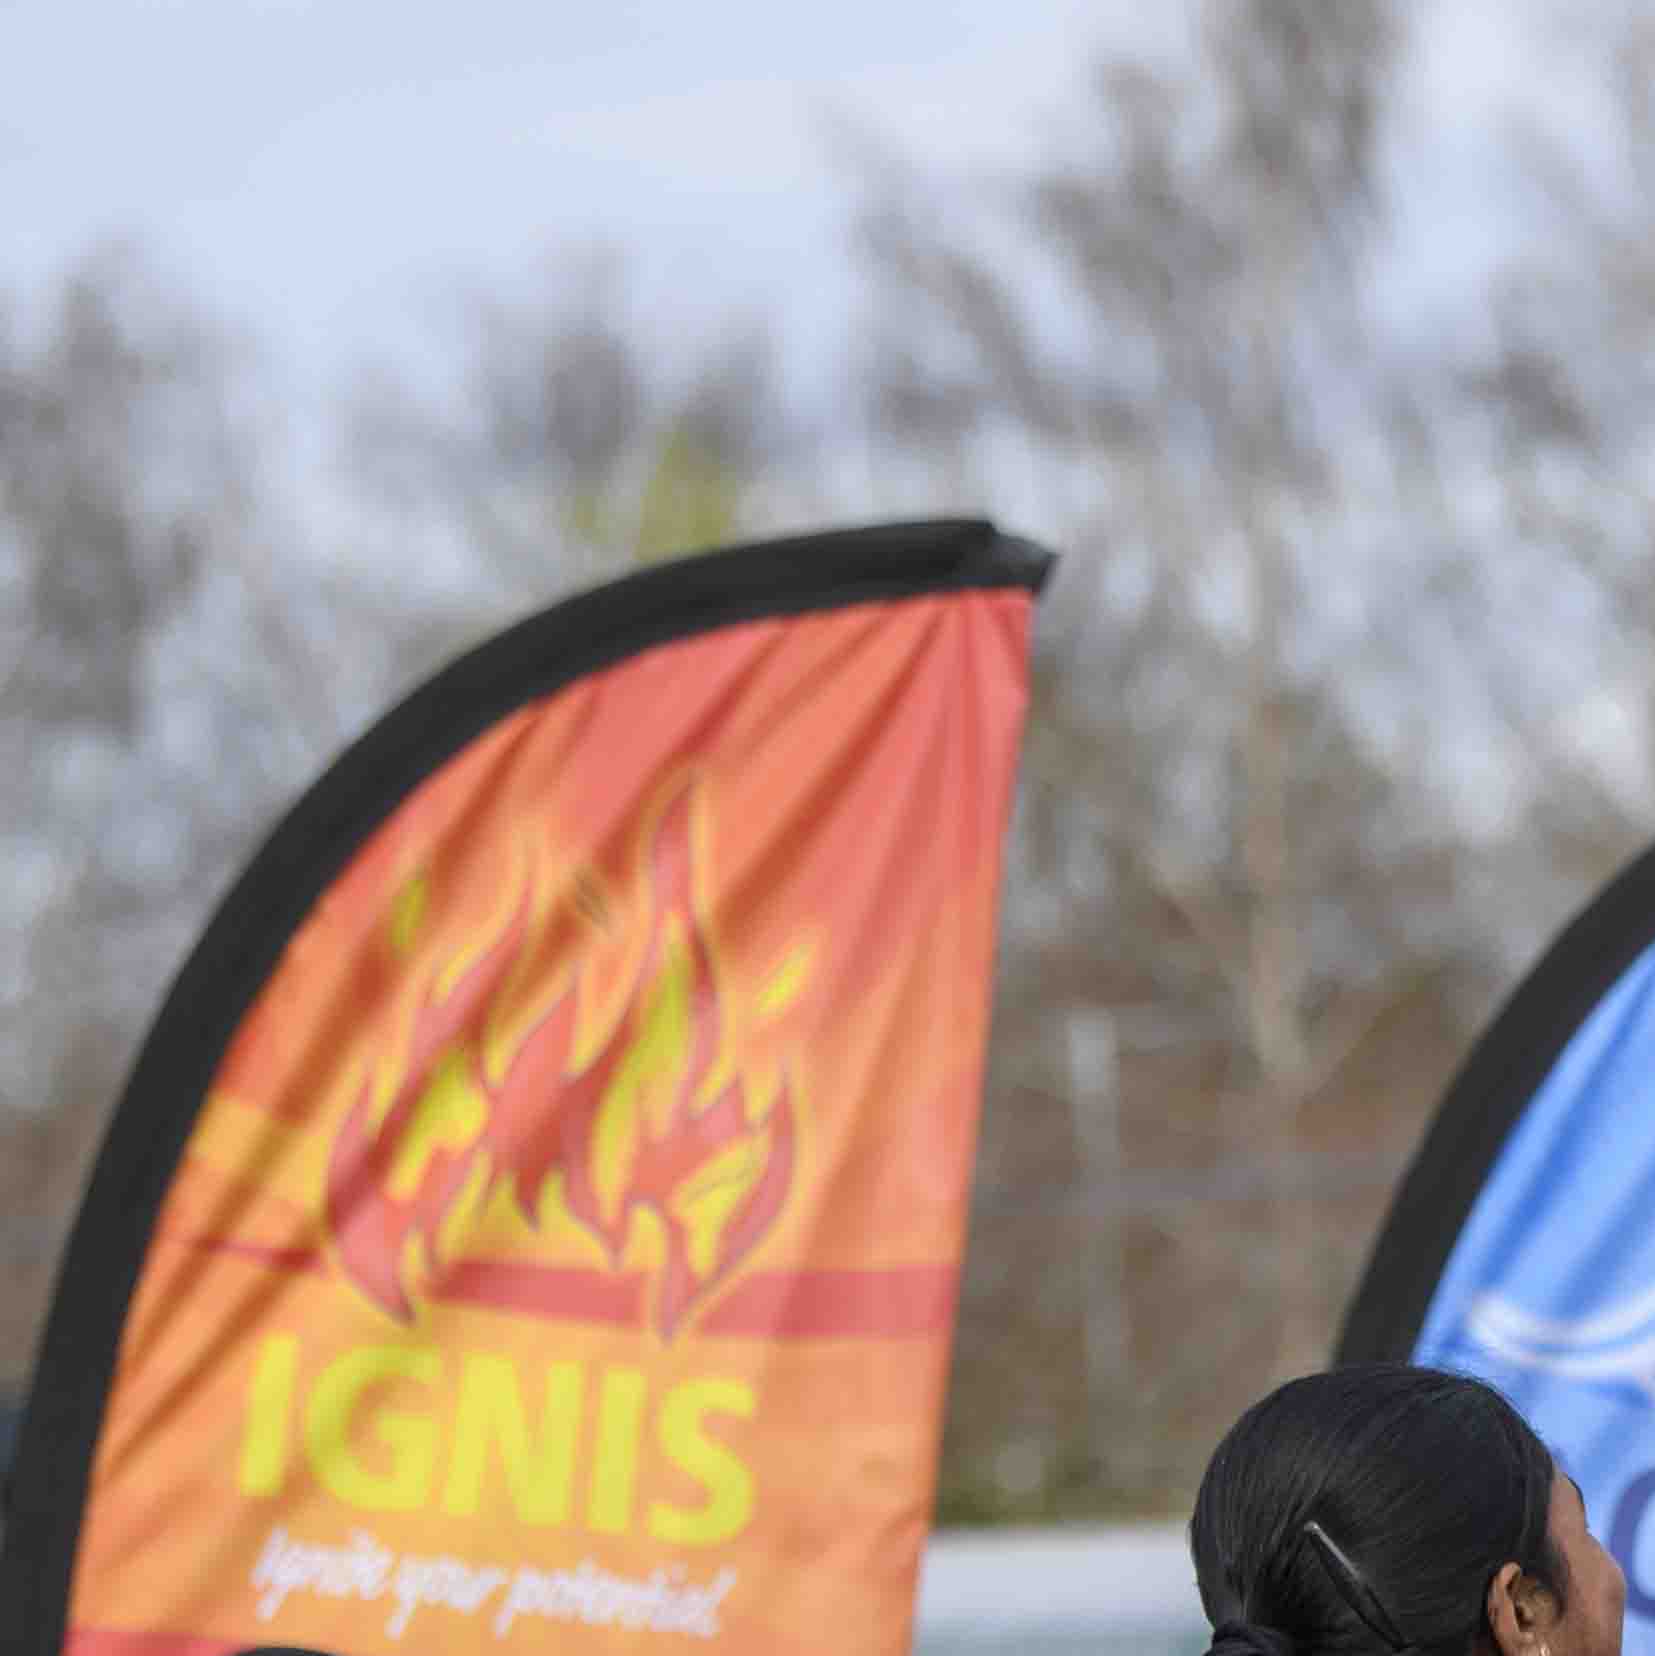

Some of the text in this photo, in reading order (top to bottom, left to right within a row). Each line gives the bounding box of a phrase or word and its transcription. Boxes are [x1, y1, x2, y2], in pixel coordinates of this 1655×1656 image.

[238, 1332, 757, 1545] IGNIS
[384, 1554, 508, 1640] your
[494, 1556, 737, 1640] potential
